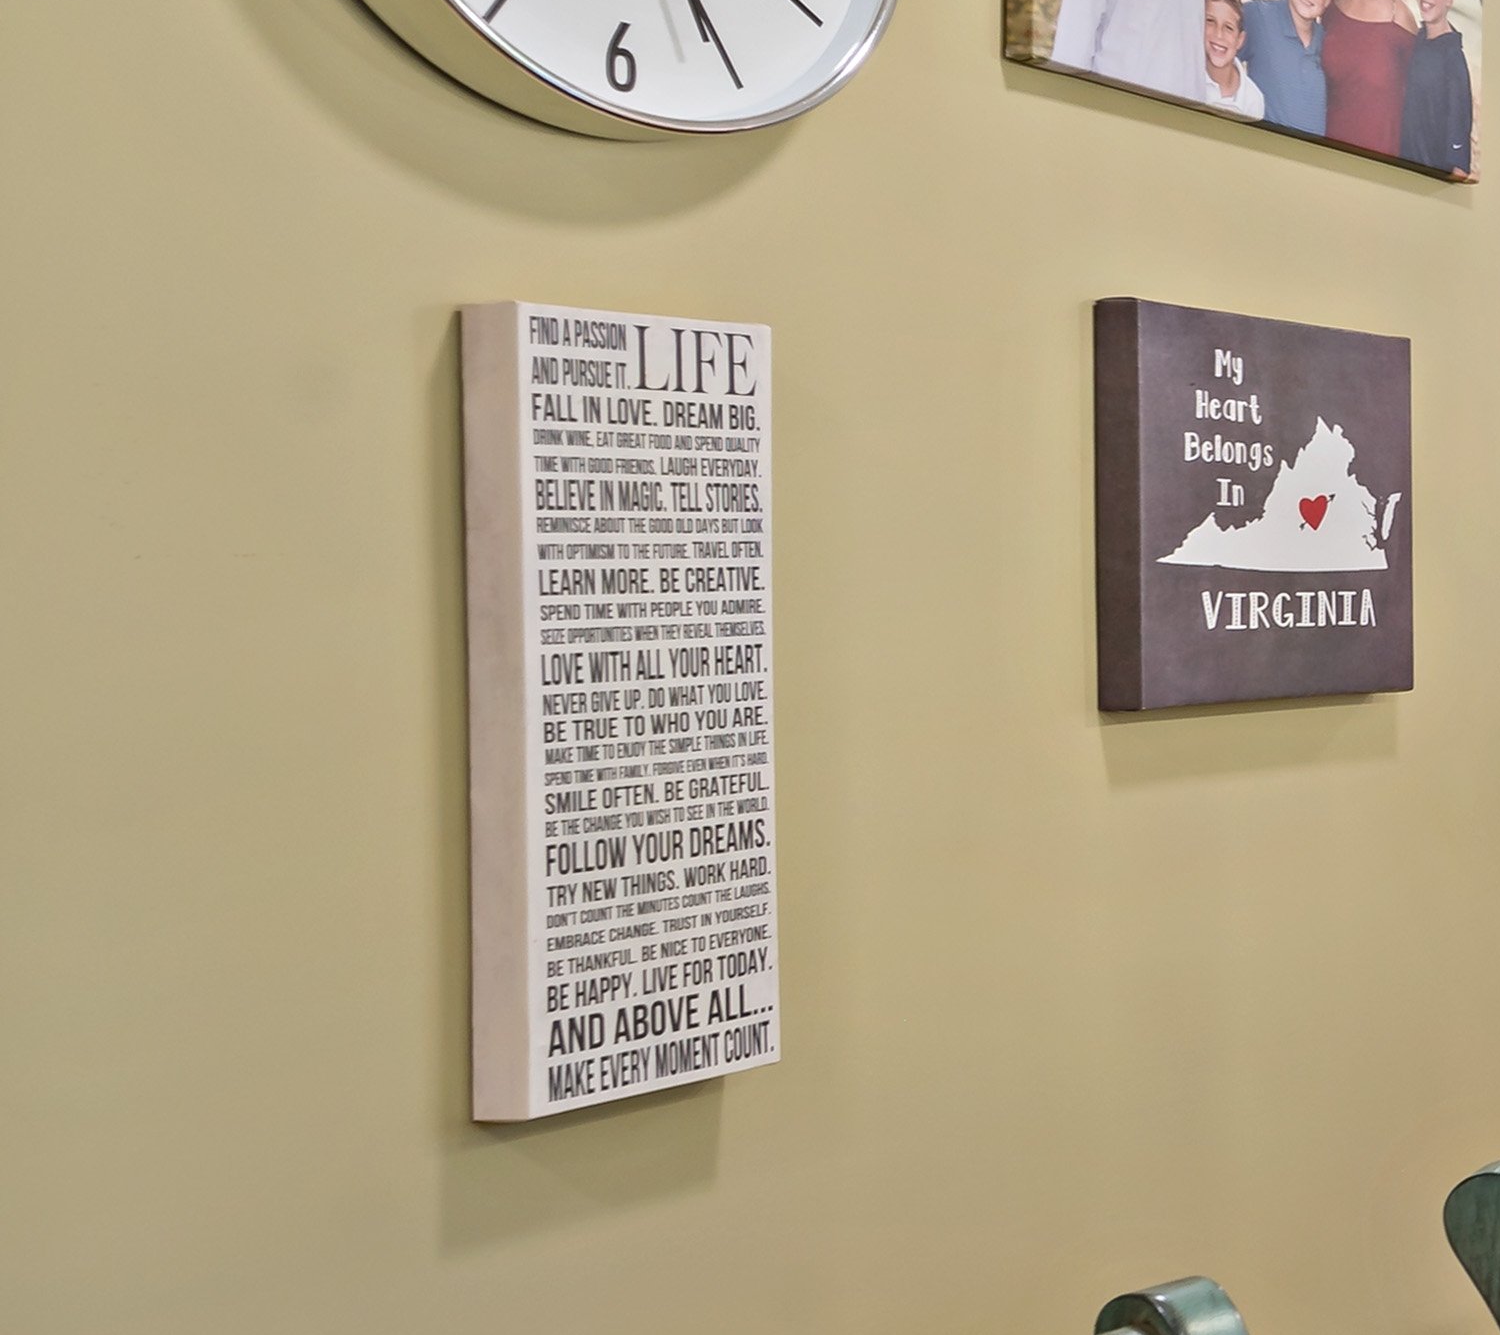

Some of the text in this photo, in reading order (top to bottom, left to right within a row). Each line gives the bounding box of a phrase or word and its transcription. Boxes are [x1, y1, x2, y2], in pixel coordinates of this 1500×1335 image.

[606, 22, 636, 92] 6
[530, 316, 626, 351] FIND A PASSION
[532, 356, 630, 390] AND PURSUE IT.
[634, 325, 757, 397] LIFE
[1213, 348, 1244, 386] My
[532, 393, 760, 432] FALL IN LOVE. DREAM BIG.
[1195, 389, 1263, 425] Heart
[534, 456, 558, 473] TIME
[561, 457, 585, 473] WITH
[588, 458, 613, 474] GOOD
[661, 456, 697, 476] LAUGH
[701, 458, 761, 478] EVERYDAY.
[1183, 432, 1274, 472] Belongs
[536, 479, 762, 513] BELIEVE IN MAGIC. TELL STORIES.
[1215, 478, 1245, 507] In
[594, 518, 626, 534] ABOUT
[629, 518, 645, 534] THE
[649, 518, 673, 534] GOOD
[676, 518, 693, 534] OLD
[696, 518, 719, 534] DAYS
[722, 519, 738, 534] BUT
[742, 519, 763, 534] LOOK
[537, 544, 564, 560] WITH
[618, 544, 629, 559] TO
[633, 544, 650, 559] THE
[693, 541, 729, 558] TRAVEL
[732, 541, 763, 558] OFTEN.
[539, 567, 765, 597] LEARN MORE. BE CREATIVE.
[541, 599, 765, 621] SPEND TIME WITH PEOPLE YOU ADMIRE.
[1200, 588, 1377, 631] VIRGINIA
[541, 644, 767, 686] LOVE WITH ALL YOUR HEART.
[543, 681, 767, 716] NEVER GIVE UP. DO WHAT YOU LOVE.
[544, 706, 768, 744] BE TRUE TO WHO YOU ARE.
[546, 747, 573, 766] MAKE
[576, 744, 600, 763] TIME
[603, 743, 615, 760] TO
[649, 739, 666, 756] THE
[669, 736, 702, 754] SIMPLE
[704, 733, 736, 751] THINGS
[738, 732, 747, 748] IN
[749, 730, 769, 747] LIFE.
[545, 771, 769, 816] SMILE OFTEN. BE GRATEFUL.
[546, 796, 769, 838] BE THE CHANGE YOU WISH TO SEE IN THE WORLD.
[546, 818, 770, 878] FOLLOW YOUR DREAMS.
[547, 856, 771, 909] TRY NEW THINGS. WORK HARD.
[547, 882, 771, 929] DON'T COUNT THE MINUTES COUNT THE LAUGHS.
[547, 929, 605, 953] EMBRACE
[663, 914, 698, 933] TRUST
[701, 912, 712, 927] IN
[716, 902, 771, 924] YOURSELF.
[548, 959, 565, 979] BE
[642, 943, 657, 962] BE
[661, 938, 687, 959] NICE
[692, 935, 706, 953] TO
[710, 924, 772, 950] EVERYONE.
[547, 946, 772, 1014] BE HAPPY. LIVE FOR TODAY.
[548, 978, 773, 1059] AND ABOVE ALL...
[549, 1020, 774, 1103] MAKE EVERY MOMENT COUNT.
